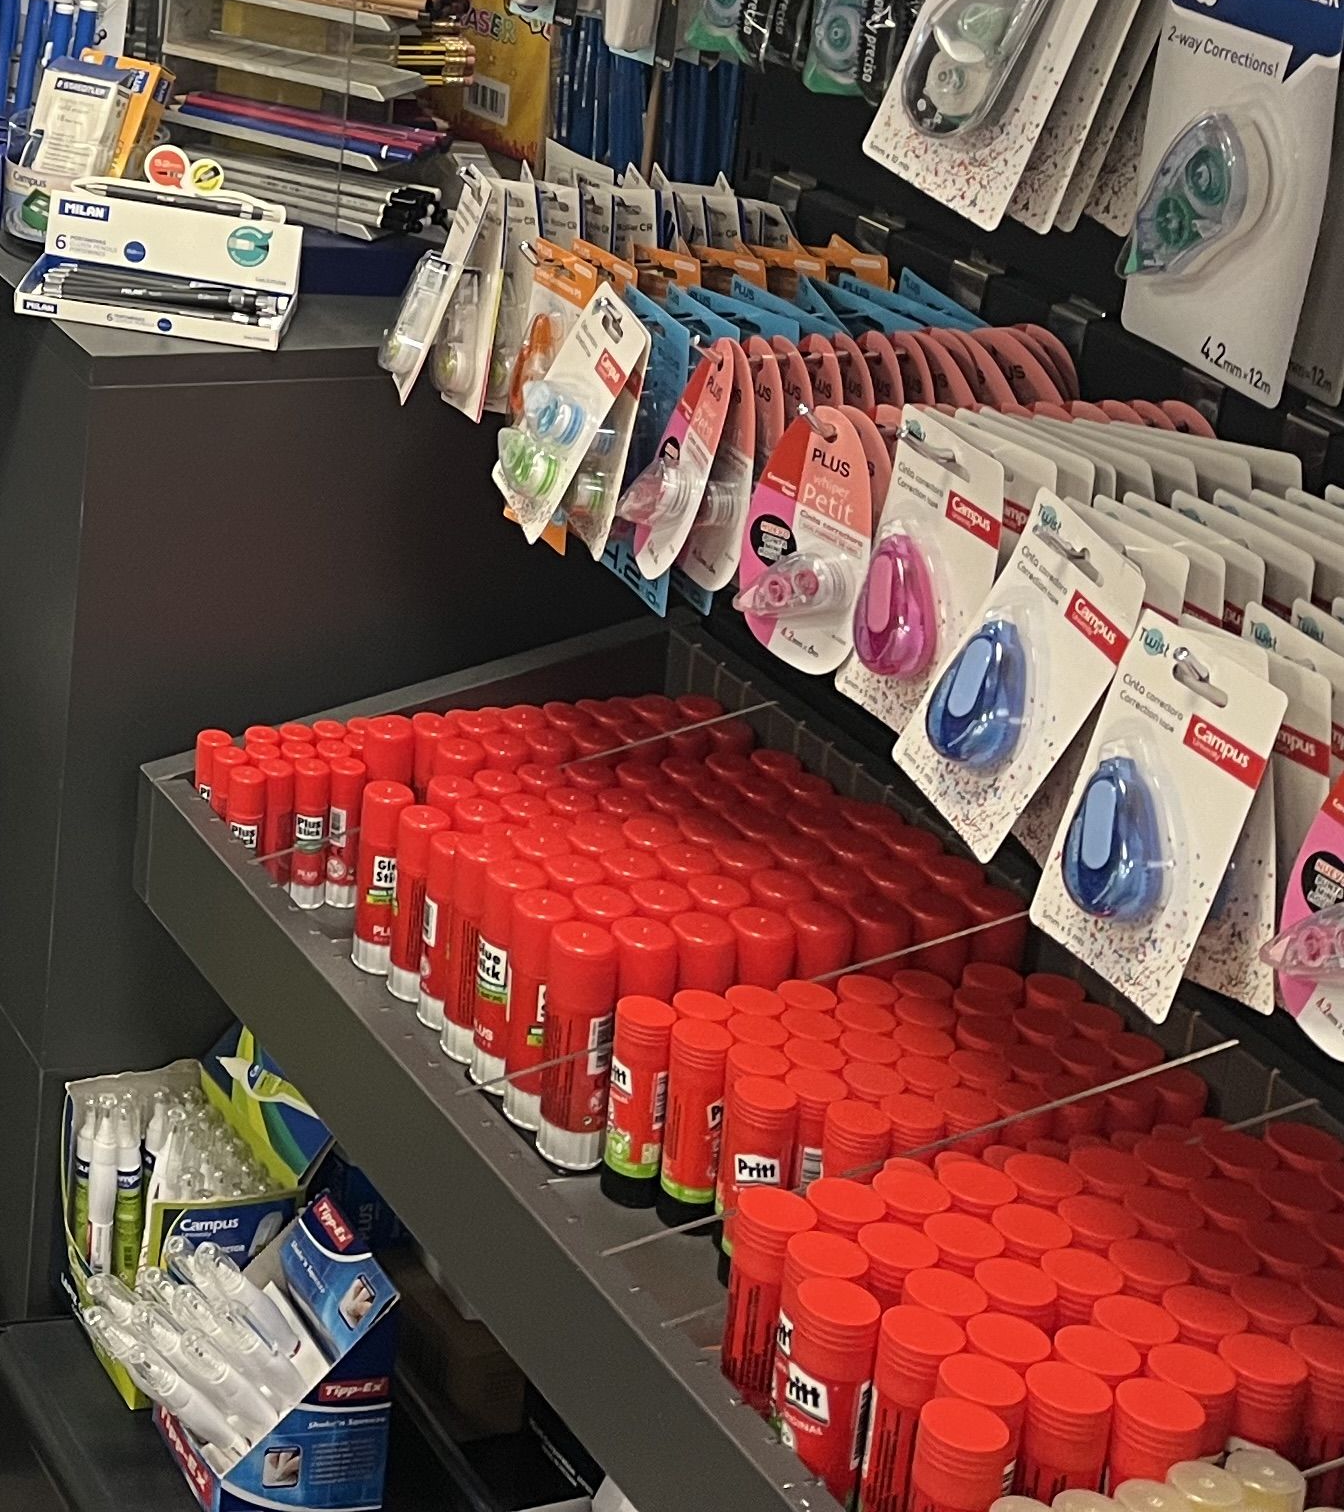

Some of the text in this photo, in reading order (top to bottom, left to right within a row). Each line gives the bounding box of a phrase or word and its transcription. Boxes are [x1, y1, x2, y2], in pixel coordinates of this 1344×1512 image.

[862, 34, 877, 84] preciso
[1167, 25, 1280, 78] 2-way Corrections!
[12, 170, 47, 189] Campus
[64, 201, 106, 219] MILAN
[639, 222, 653, 233] CR
[55, 233, 67, 250] 6
[25, 300, 55, 313] MILAN
[811, 447, 851, 479] PLUS
[802, 481, 855, 527] Petit
[951, 496, 992, 533] Campus
[1038, 503, 1063, 533] Twist
[1020, 545, 1039, 568] Cinta
[1074, 597, 1118, 646] Campus
[1138, 627, 1171, 659] Twist
[1122, 672, 1145, 695] Cinta
[1119, 689, 1160, 722] Correction
[1193, 721, 1250, 769] Campus
[230, 825, 256, 838] Plus
[297, 816, 322, 830] Plus
[736, 1157, 777, 1179] Pritt
[180, 1216, 240, 1235] Campus
[316, 1198, 352, 1245] Tipp-Ex
[323, 1379, 385, 1397] Tipp-Ex
